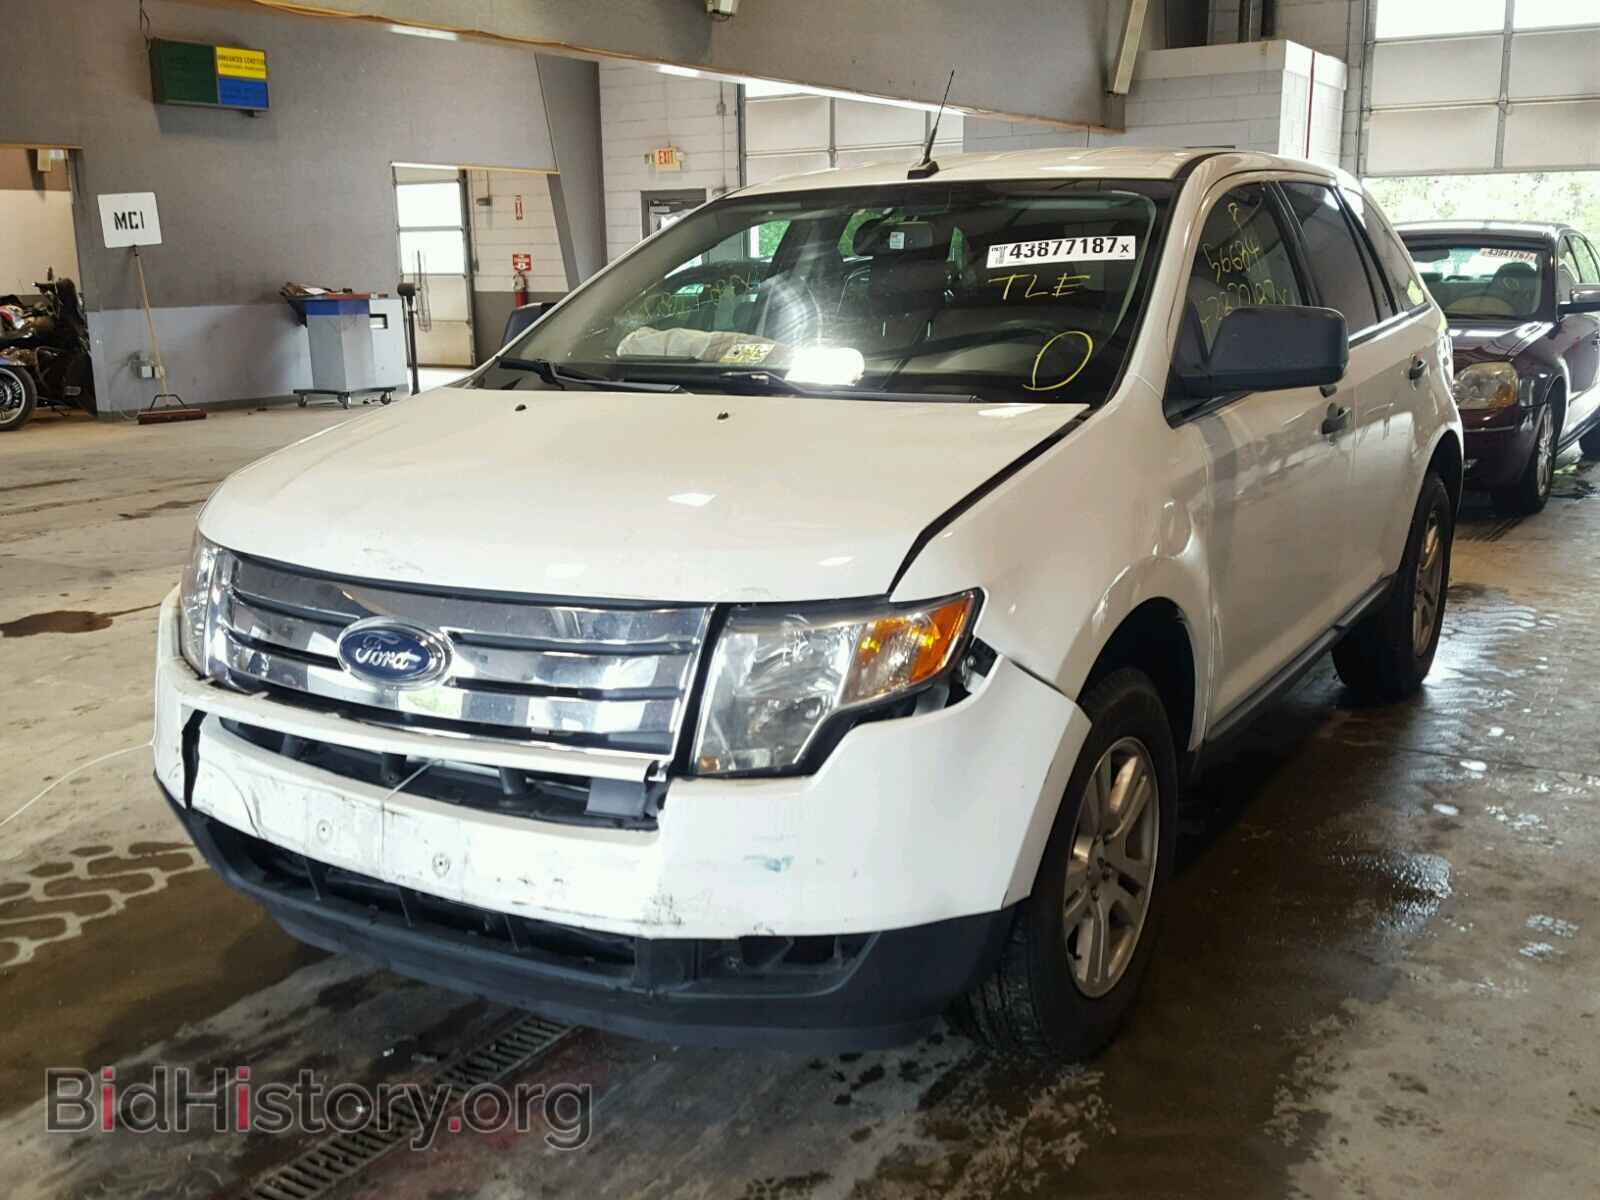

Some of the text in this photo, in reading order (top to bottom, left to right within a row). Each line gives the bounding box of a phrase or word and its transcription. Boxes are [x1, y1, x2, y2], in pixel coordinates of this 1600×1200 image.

[658, 149, 674, 165] EXIT
[113, 210, 145, 231] MCI
[355, 632, 422, 671] Ford
